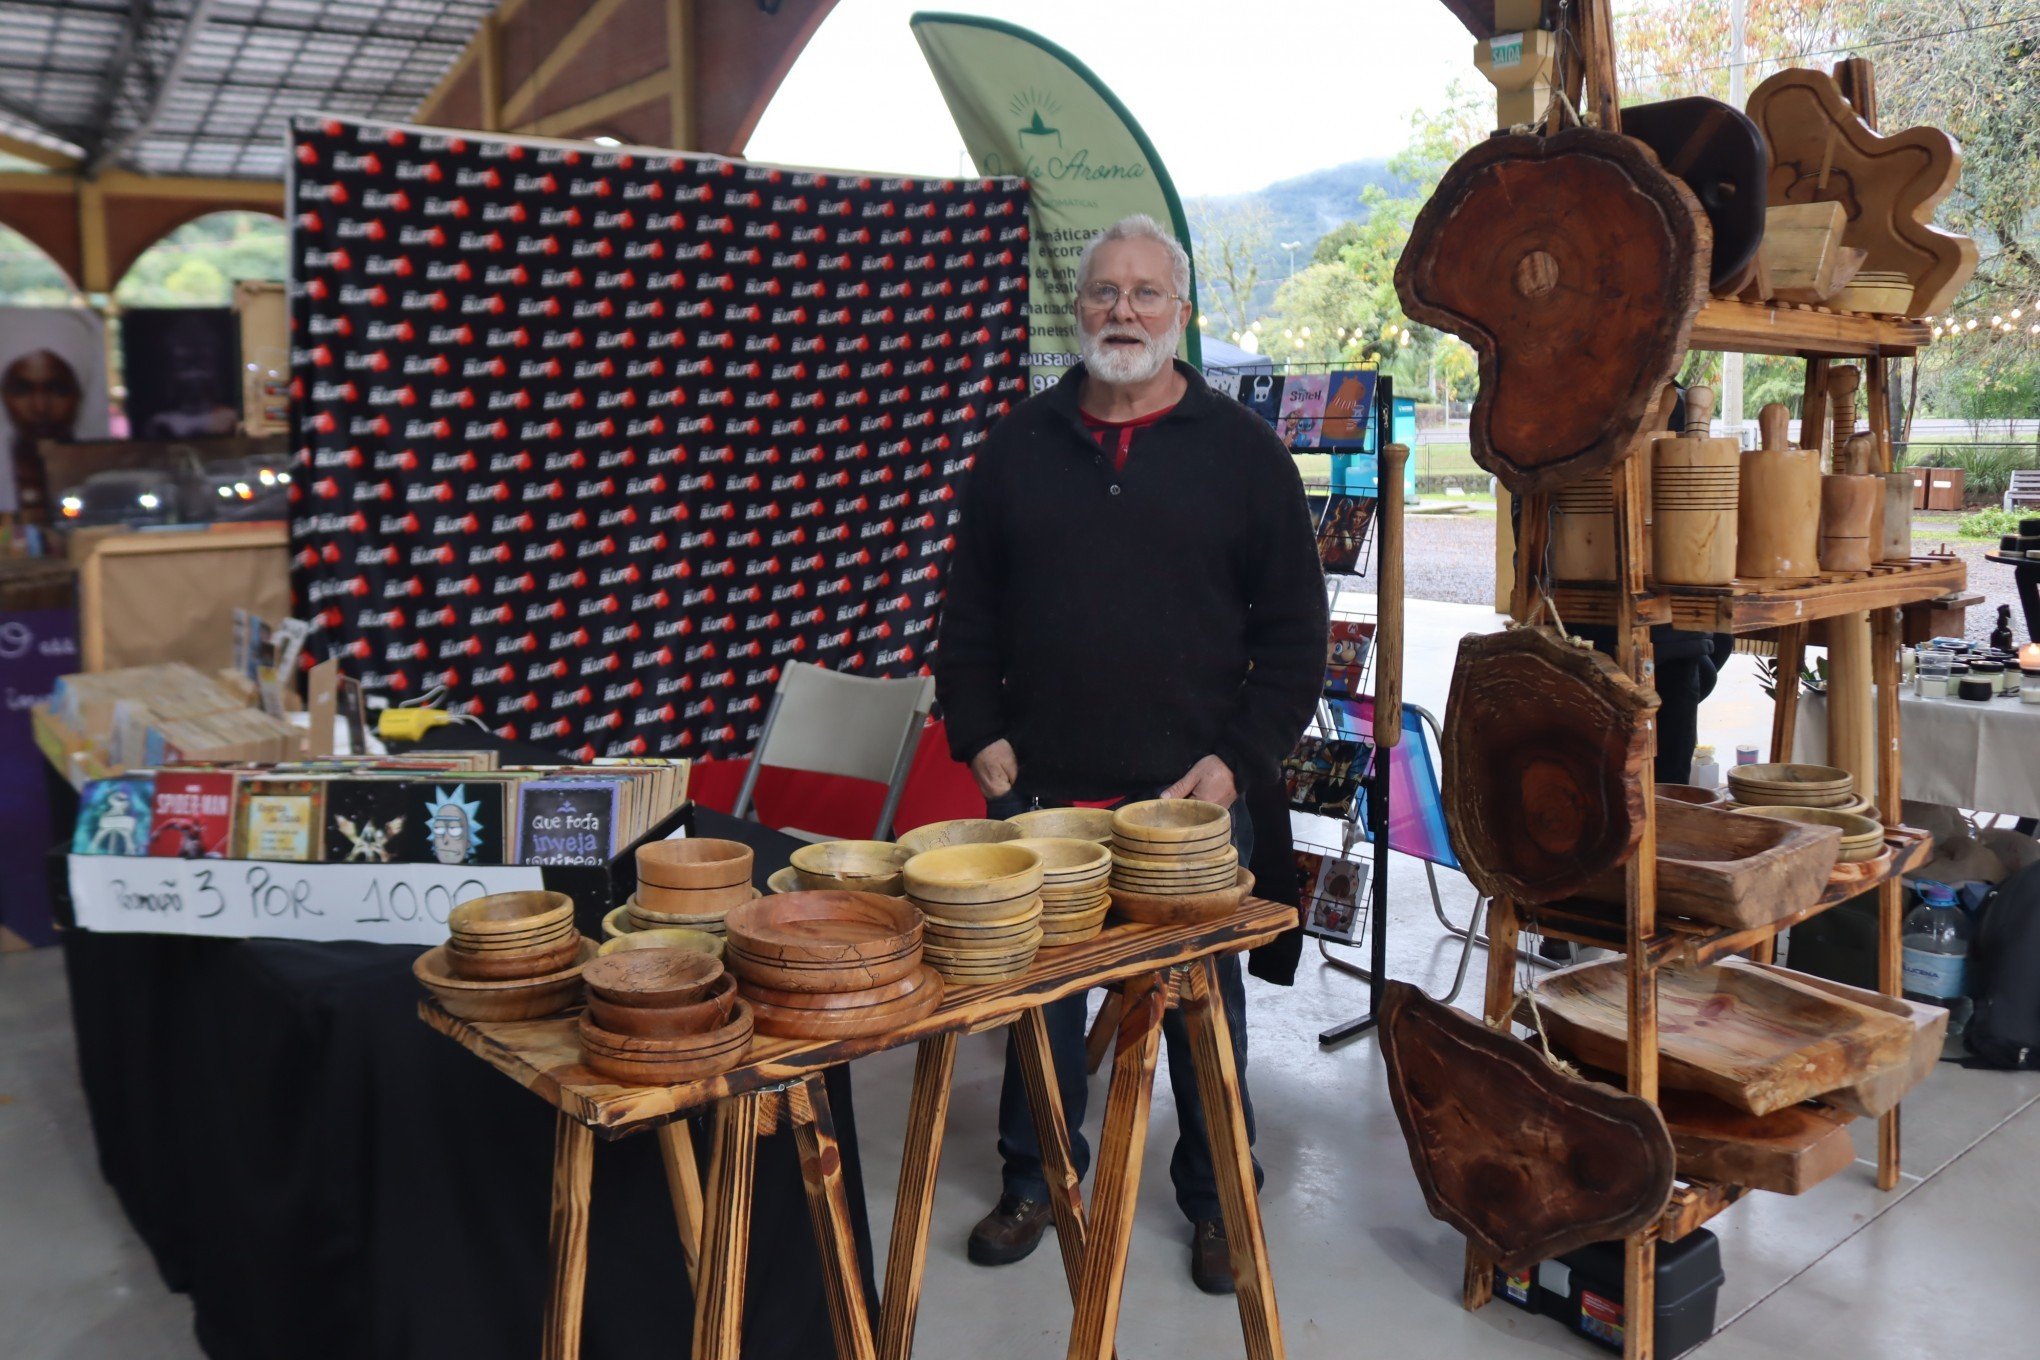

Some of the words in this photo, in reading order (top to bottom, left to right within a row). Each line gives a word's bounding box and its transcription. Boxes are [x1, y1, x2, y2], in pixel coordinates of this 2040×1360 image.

[1048, 148, 1145, 180] Aroma
[981, 302, 1008, 317] BLUFF
[984, 352, 1006, 367] BLUFF
[959, 380, 987, 396] BLUFF
[903, 412, 930, 428] BLUFF
[942, 407, 968, 423] BLUFF
[677, 418, 708, 434] BLUFF
[648, 448, 680, 464] BLUFF
[878, 441, 905, 456] BLUFF
[772, 475, 800, 490] BLUFF
[816, 473, 844, 488] BLUFF
[860, 469, 886, 484] BLUFF
[879, 494, 906, 510] BLUFF
[918, 487, 947, 504] BLUFF
[791, 502, 818, 517] BLUFF
[835, 498, 862, 514] BLUFF
[861, 522, 889, 537] BLUFF
[902, 516, 928, 531] BLUFF
[680, 532, 709, 548] BLUFF
[727, 532, 755, 547] BLUFF
[772, 530, 800, 546] BLUFF
[816, 526, 844, 542] BLUFF
[628, 536, 660, 552] BLUFF
[921, 538, 951, 556] BLUFF
[746, 560, 774, 575] BLUFF
[791, 556, 818, 572] BLUFF
[836, 551, 864, 568] BLUFF
[600, 568, 632, 585] BLUFF
[652, 563, 684, 580] BLUFF
[701, 562, 730, 576] BLUFF
[901, 566, 932, 584] BLUFF
[727, 588, 755, 602] BLUFF
[772, 584, 800, 600] BLUFF
[816, 580, 845, 596] BLUFF
[876, 597, 905, 613] BLUFF
[701, 617, 730, 632] BLUFF
[791, 610, 818, 626] BLUFF
[654, 620, 686, 638] BLUFF
[857, 625, 885, 641] BLUFF
[772, 638, 799, 654] BLUFF
[817, 632, 847, 649] BLUFF
[727, 643, 755, 658] BLUFF
[876, 648, 907, 665] BLUFF
[746, 669, 774, 685] BLUFF
[656, 677, 687, 695] BLUFF
[727, 698, 755, 713] BLUFF
[634, 707, 668, 725] BLUFF
[194, 869, 225, 918] 3
[245, 866, 324, 919] POR
